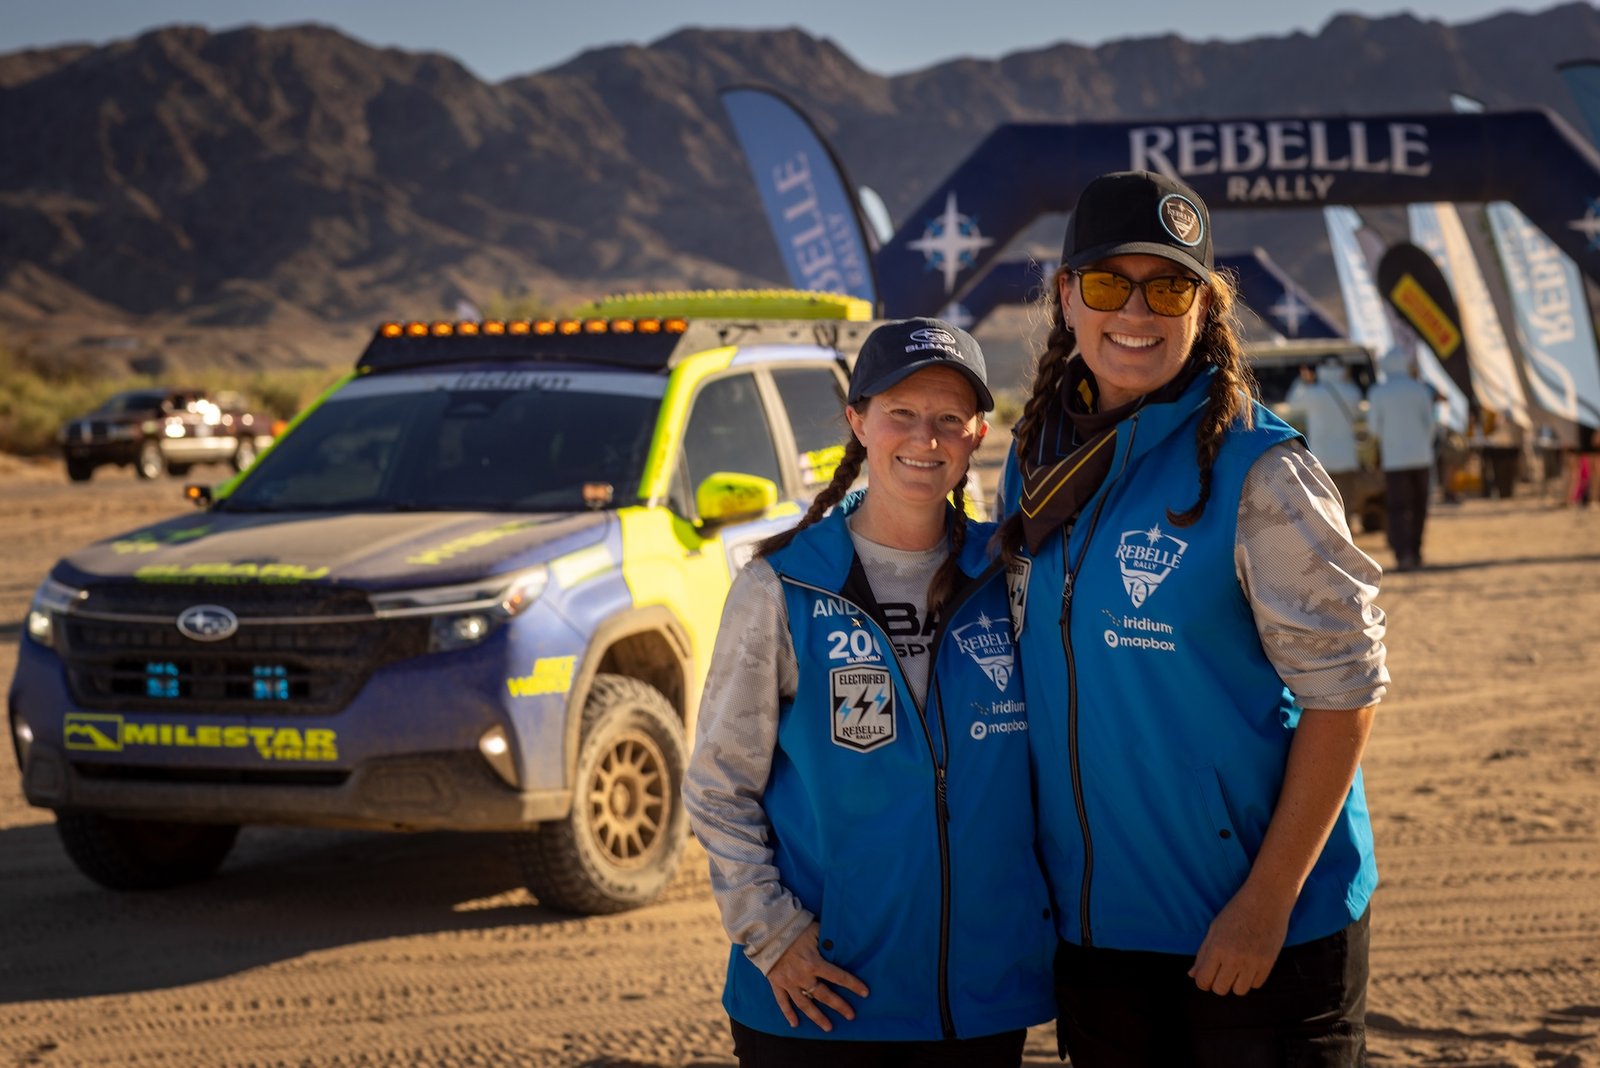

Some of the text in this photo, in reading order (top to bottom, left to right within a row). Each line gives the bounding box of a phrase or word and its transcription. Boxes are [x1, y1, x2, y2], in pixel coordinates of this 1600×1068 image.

[1128, 121, 1432, 183] REBELLE
[1227, 174, 1336, 202] RALLY
[905, 343, 964, 360] SUBARU
[1115, 544, 1182, 569] REBELLE
[1133, 560, 1157, 571] RALLY
[1123, 615, 1174, 634] iridium
[897, 643, 932, 657] SP
[957, 632, 1013, 654] REBELL
[983, 646, 1006, 655] RALLY
[1120, 636, 1176, 652] mapbox
[840, 674, 885, 685] ELECTRIFIED
[124, 723, 337, 749] MILESTAR
[842, 725, 885, 738] REBELLE
[259, 747, 338, 761] TIRES
